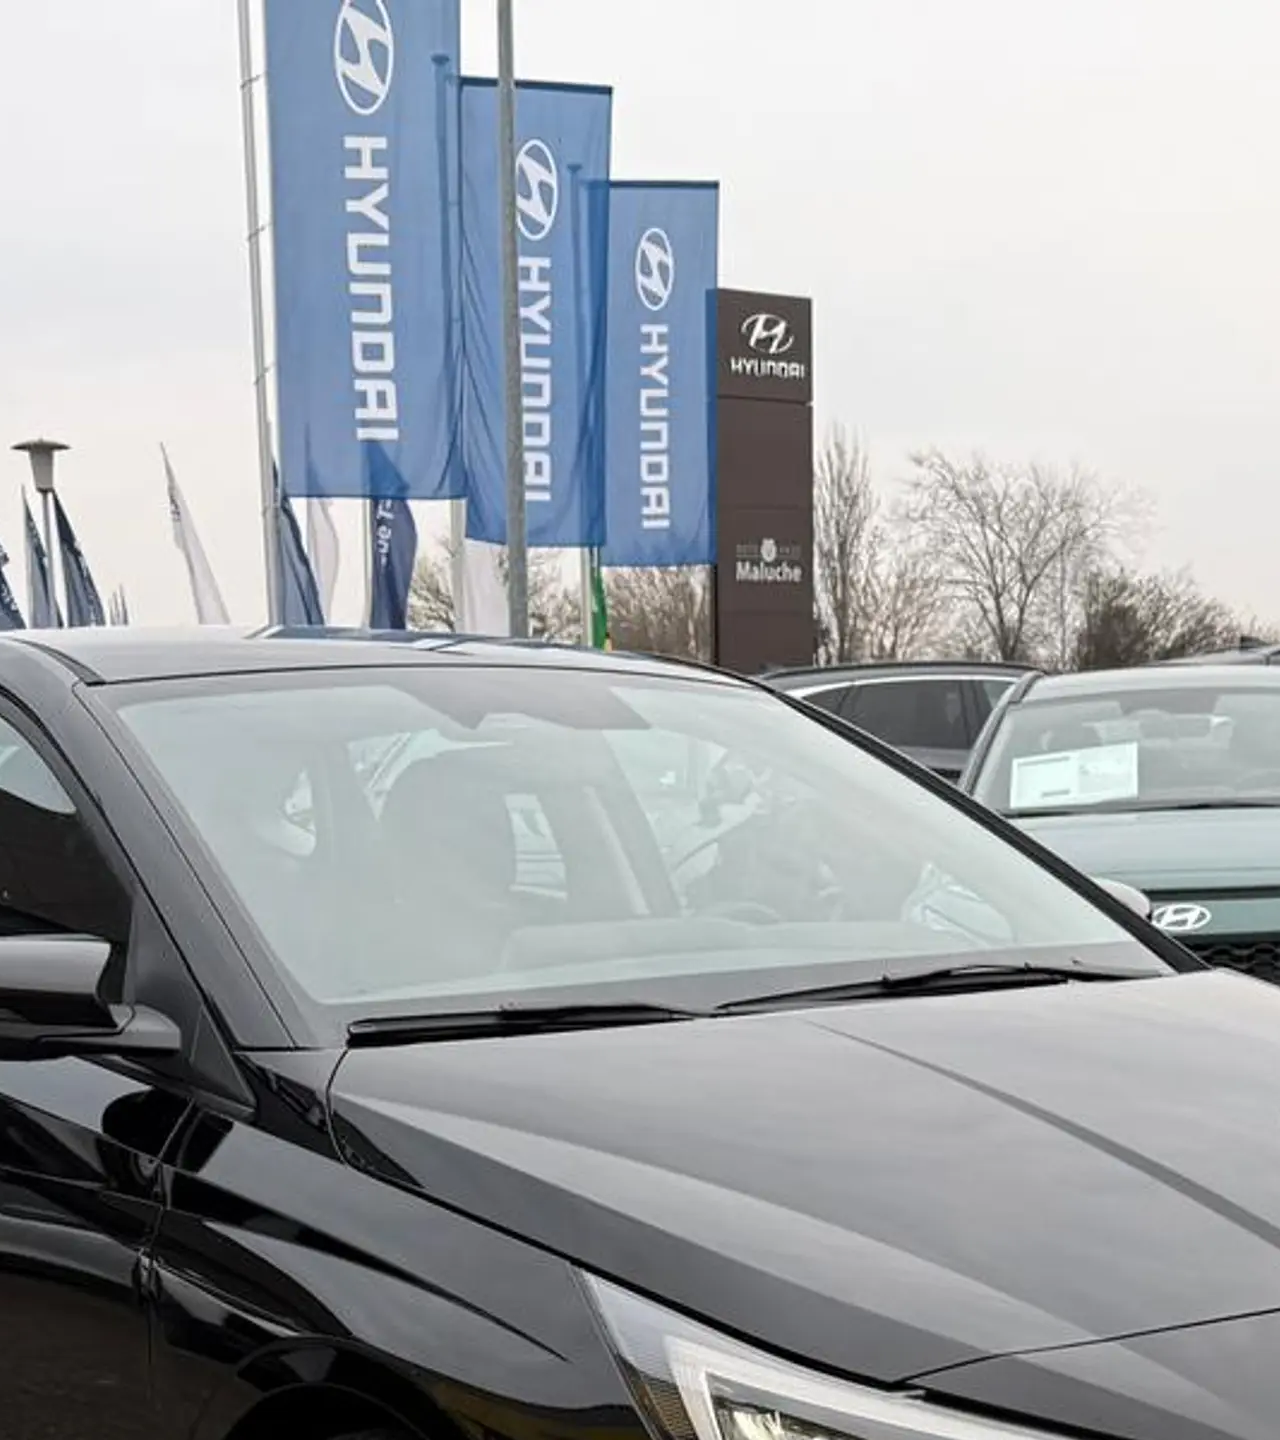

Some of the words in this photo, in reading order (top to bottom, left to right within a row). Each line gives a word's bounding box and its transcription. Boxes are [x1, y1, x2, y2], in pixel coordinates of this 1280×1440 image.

[344, 136, 399, 441] HYUNDAI
[517, 255, 552, 501] HYUNDAI
[730, 356, 805, 379] HYUNDAI
[639, 323, 670, 530] HYUNDAI
[735, 560, 802, 583] Maluche
